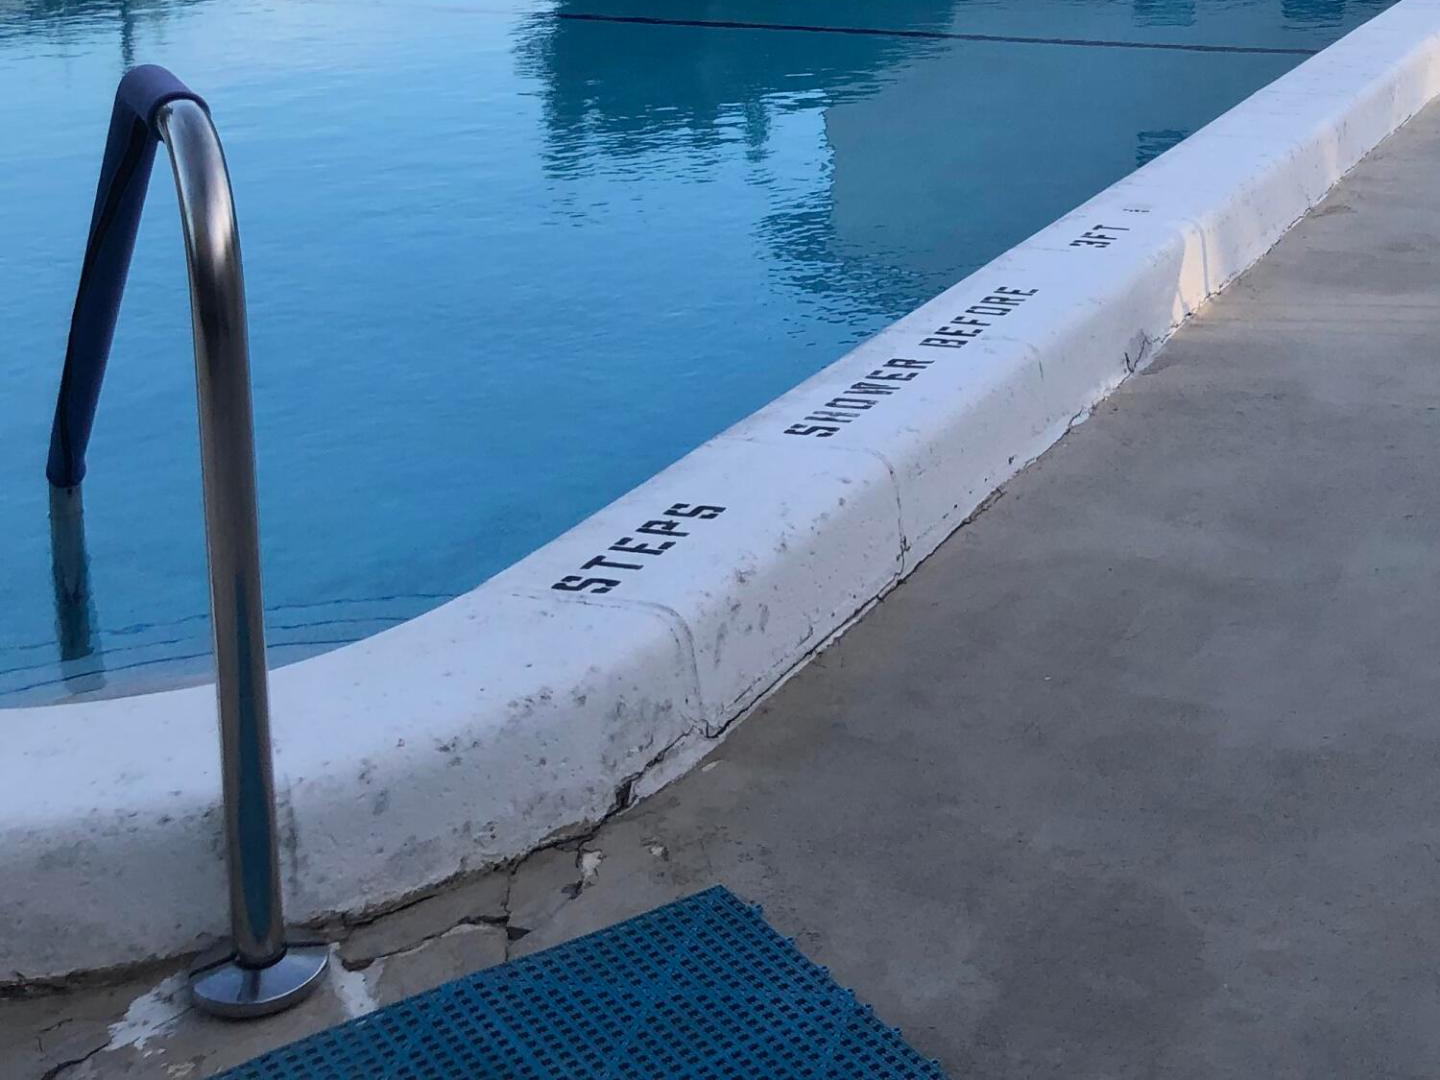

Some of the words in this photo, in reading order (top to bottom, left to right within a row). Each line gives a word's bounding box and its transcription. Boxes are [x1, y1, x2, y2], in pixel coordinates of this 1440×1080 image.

[1069, 224, 1130, 249] 3FT
[784, 358, 935, 438] SHOWER
[919, 286, 1039, 349] BEFORE
[551, 503, 726, 594] STEPS
